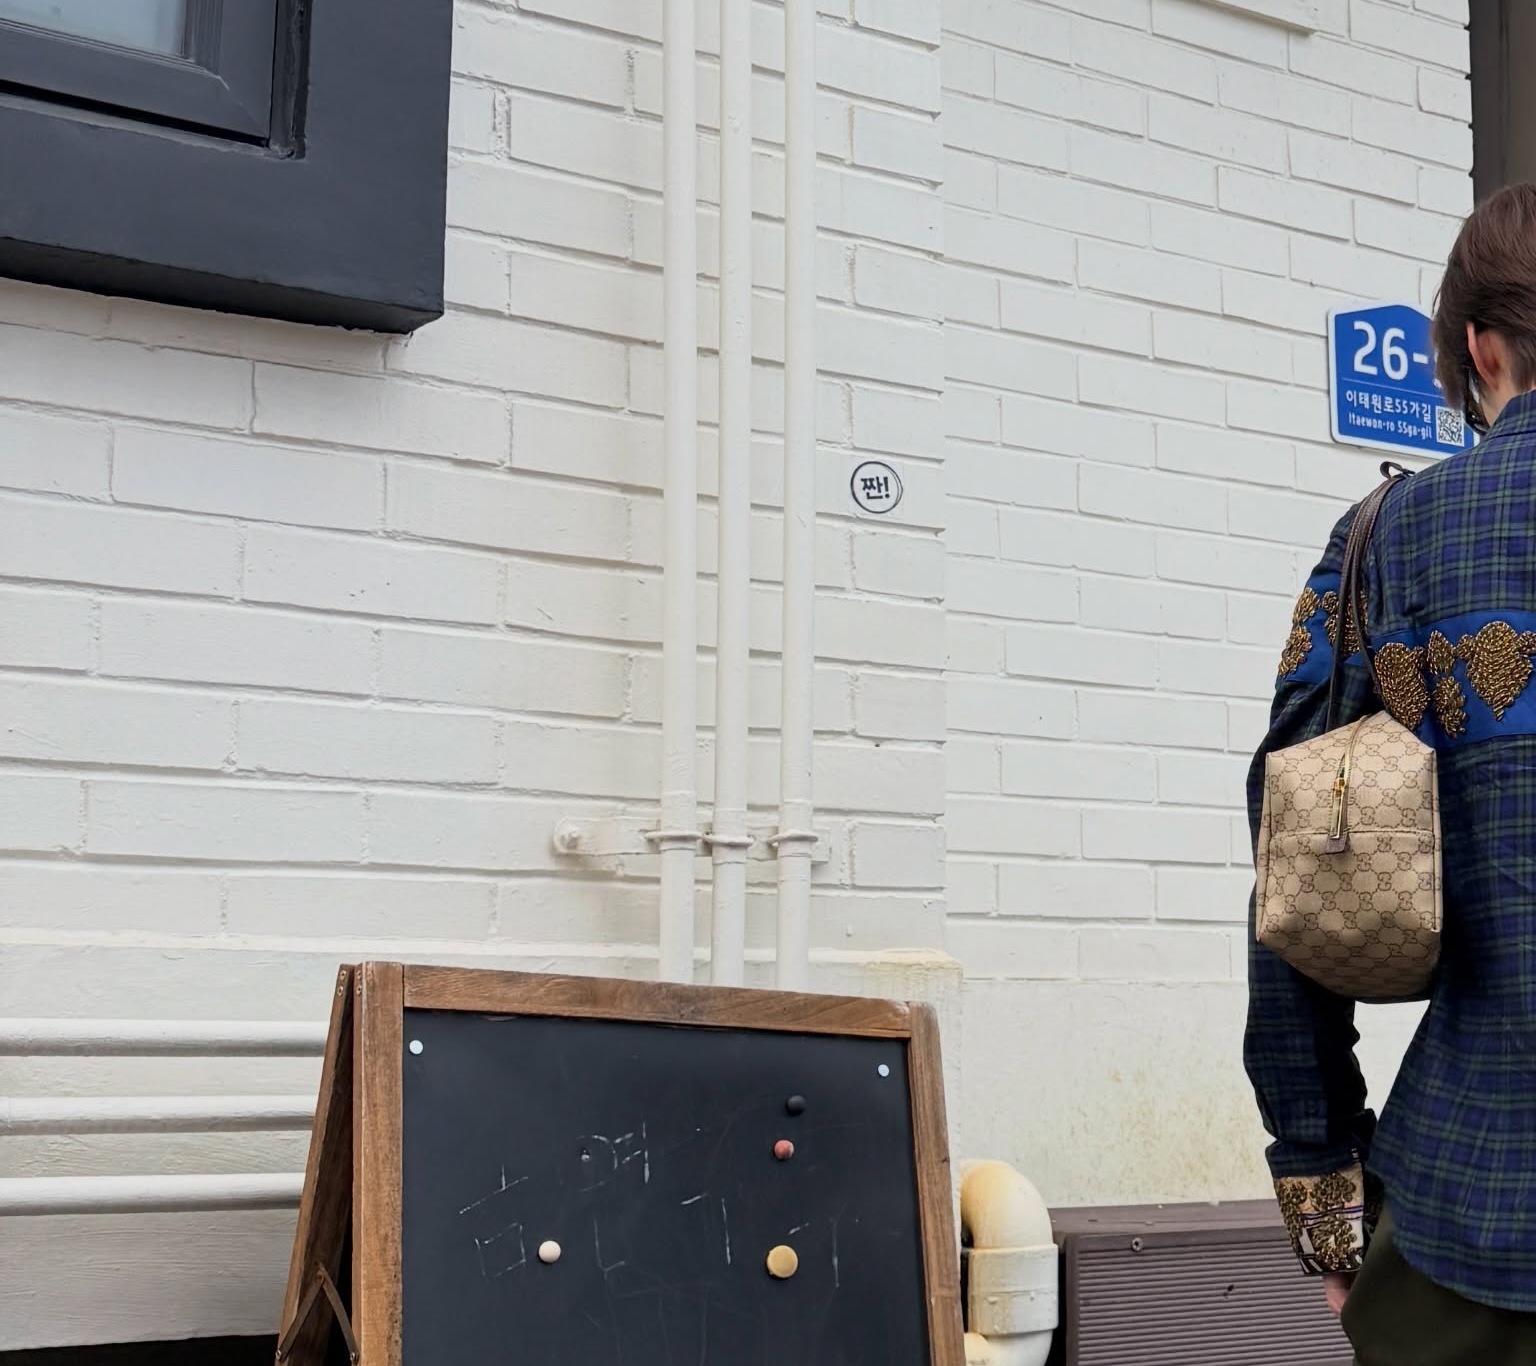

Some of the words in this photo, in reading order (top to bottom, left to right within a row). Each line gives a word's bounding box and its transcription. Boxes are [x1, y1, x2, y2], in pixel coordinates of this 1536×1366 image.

[1353, 320, 1443, 389] 26-
[1346, 390, 1432, 424] 이태원로55가길
[1348, 412, 1395, 432] Itaewon-ro
[1398, 421, 1432, 440] 55ga-gil
[860, 476, 890, 500] 짠!
